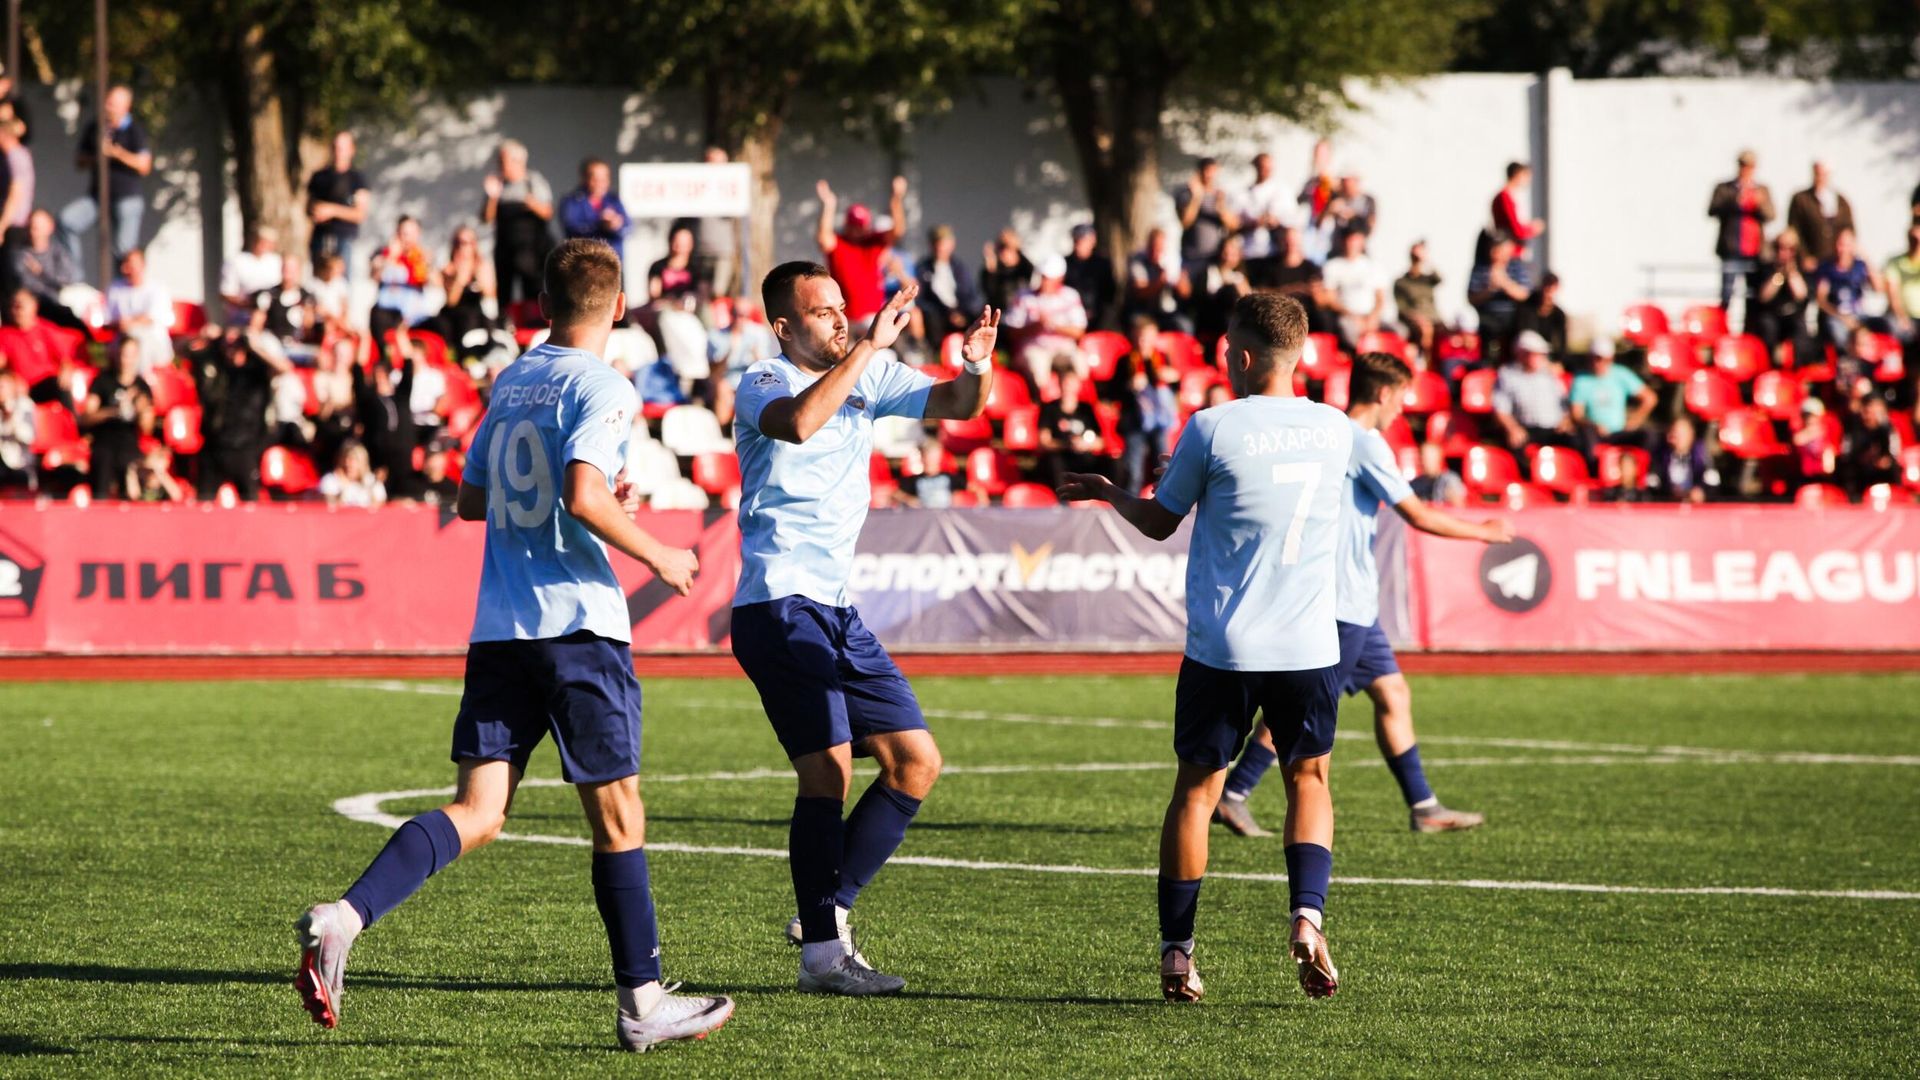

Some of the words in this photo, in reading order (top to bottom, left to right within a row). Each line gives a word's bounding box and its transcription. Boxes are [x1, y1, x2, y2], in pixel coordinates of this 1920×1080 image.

[1244, 427, 1339, 457] ЗАХАРОВ
[1272, 462, 1322, 565] 7
[76, 562, 292, 600] ЛИГА
[317, 562, 367, 600] Б
[1576, 550, 1920, 603] FNLEAGU
